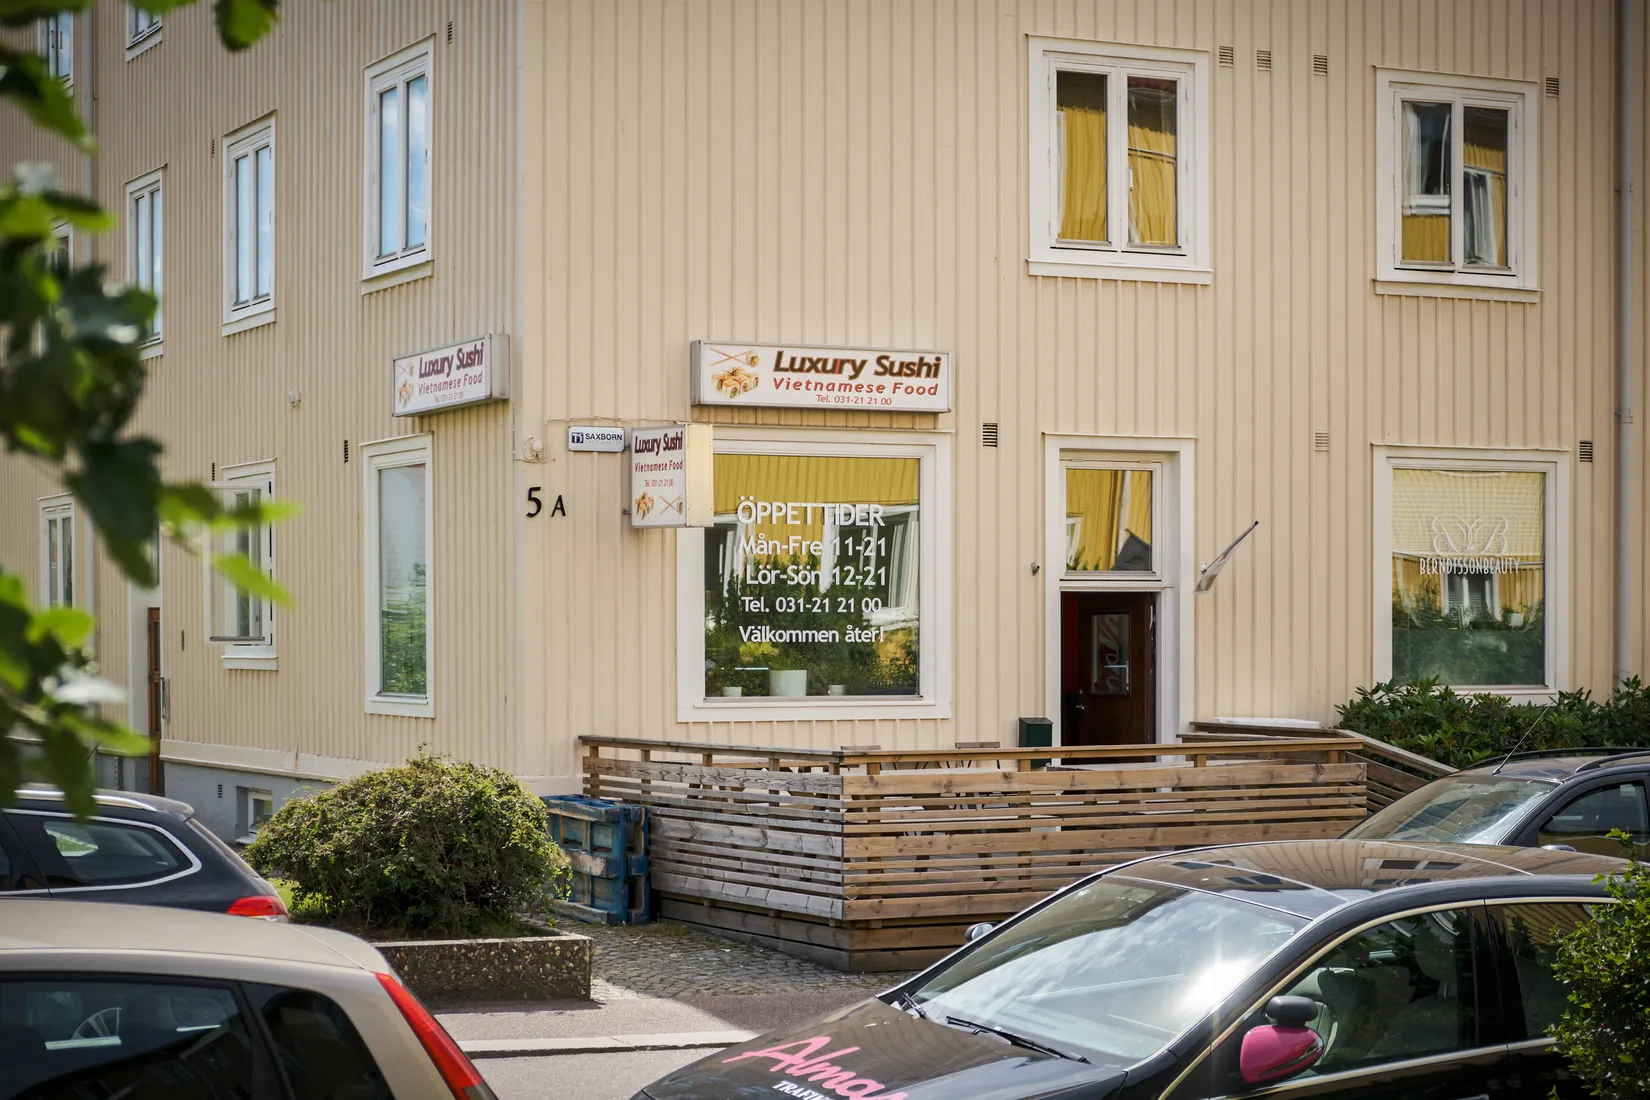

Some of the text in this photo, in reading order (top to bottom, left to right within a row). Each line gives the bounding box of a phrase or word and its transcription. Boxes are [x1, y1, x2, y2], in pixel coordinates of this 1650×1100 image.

[418, 341, 484, 379] Luxury Sushi
[773, 350, 942, 380] Luxury Sushi
[418, 370, 483, 396] Vietnamese Food
[773, 377, 938, 396] Vietnamese Food
[816, 394, 892, 405] Tel. 031-21 21 00
[585, 433, 622, 441] SAXBORN
[634, 430, 683, 456] Luxury Sushi
[634, 459, 683, 472] Vietnamese Food
[526, 486, 566, 518] 5 A
[739, 533, 886, 556] Mån-Fre 11-21
[746, 564, 886, 586] Lör-Sön 12-21
[741, 596, 882, 613] Tel. 031-21 21 00
[738, 624, 884, 643] Välkommen åter!
